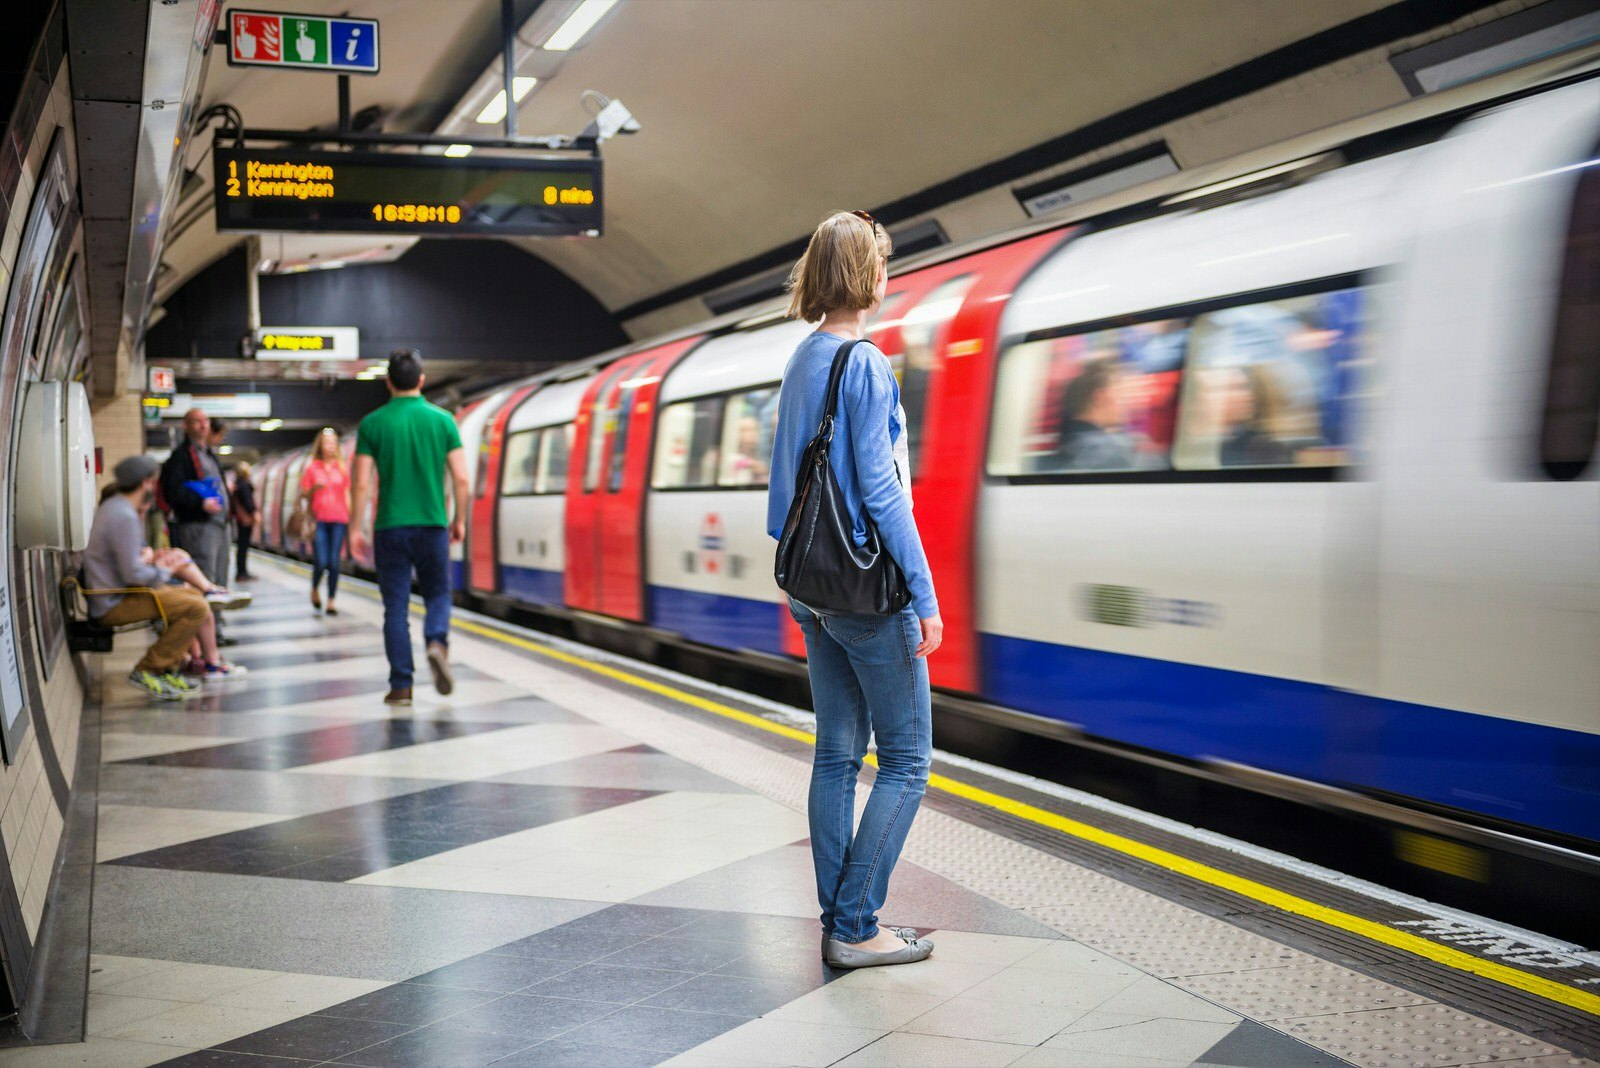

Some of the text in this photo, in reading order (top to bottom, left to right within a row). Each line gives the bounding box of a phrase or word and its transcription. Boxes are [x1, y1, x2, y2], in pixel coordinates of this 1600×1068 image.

[346, 28, 361, 61] i
[228, 160, 334, 182] 1 Kennington
[226, 178, 334, 200] 2 Kennington
[559, 187, 594, 205] mins
[1391, 917, 1586, 968] MIND
